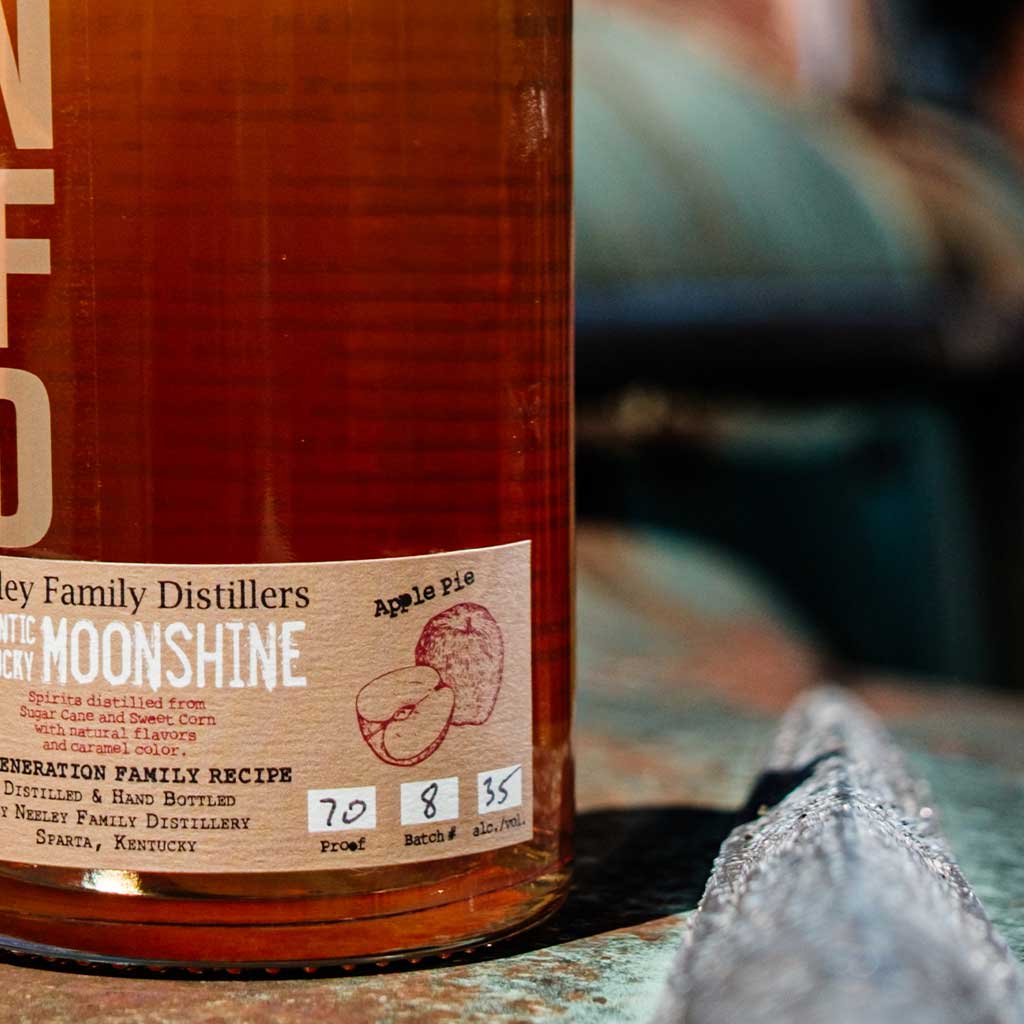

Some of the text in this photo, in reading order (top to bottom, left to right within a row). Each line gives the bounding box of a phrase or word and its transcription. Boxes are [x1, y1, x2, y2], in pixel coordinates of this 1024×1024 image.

[43, 576, 147, 614] Family
[157, 580, 310, 610] Distillers
[373, 570, 476, 618] Apple Pie
[40, 615, 307, 692] MOONSHINE
[28, 691, 206, 710] Spirits distilled from
[19, 706, 217, 726] Sugar Cane and Sweet Corn
[34, 724, 197, 742] with natural flavors
[42, 740, 187, 757] and caramel color.
[114, 766, 200, 784] FAMILY
[208, 767, 293, 784] RECIPE
[483, 765, 522, 807] 35
[3, 780, 236, 808] DISTILLED & HAND BOTTLED
[420, 782, 439, 819] 8
[14, 804, 69, 825] NEELEY
[76, 810, 137, 830] FAMILY
[319, 797, 367, 826] 70
[472, 813, 526, 837] alc./vol.
[114, 835, 197, 853] KENTUCKY
[320, 839, 366, 853] Proof
[404, 828, 457, 847] Batch #
